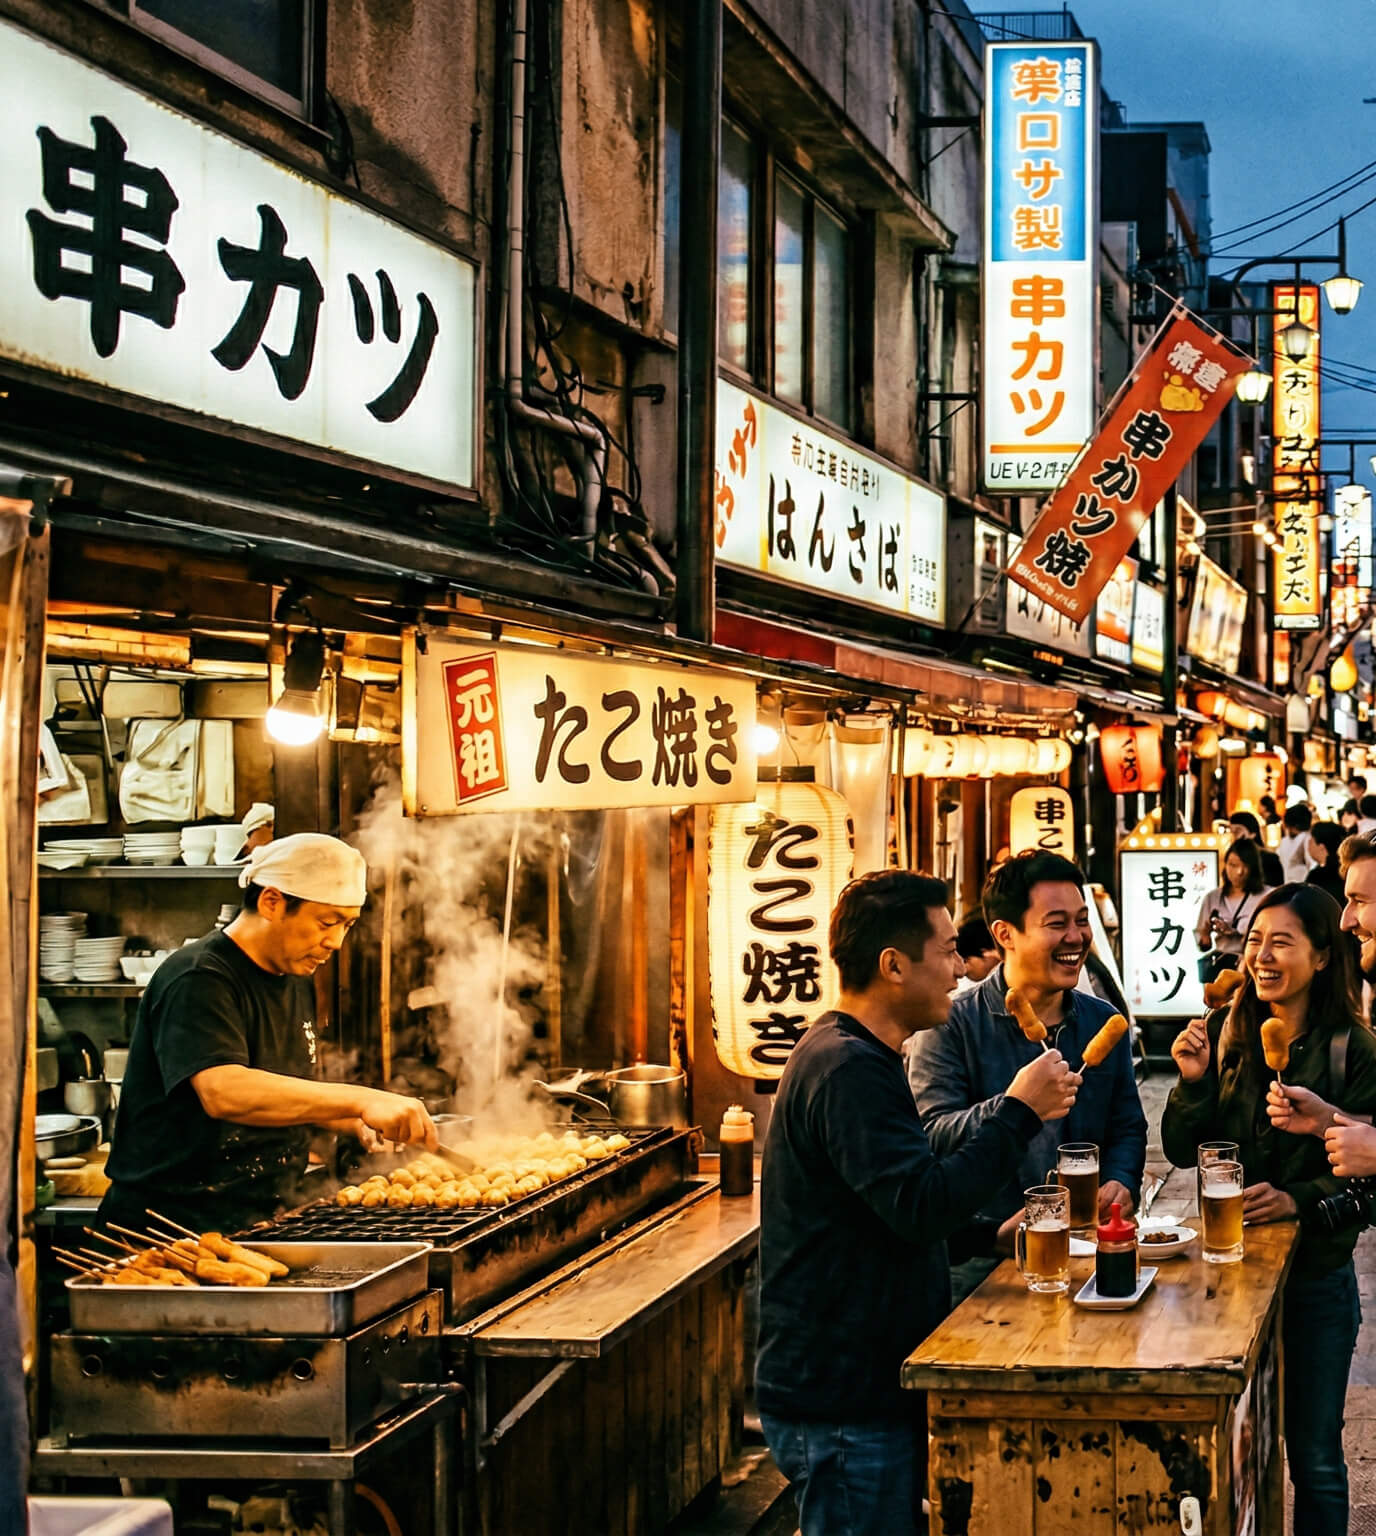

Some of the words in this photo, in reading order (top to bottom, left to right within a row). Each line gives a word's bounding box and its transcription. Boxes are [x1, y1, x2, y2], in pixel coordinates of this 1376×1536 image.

[26, 115, 439, 423] 串カツ
[1010, 275, 1066, 437] 串カツ
[767, 472, 900, 594] はんさば
[455, 668, 500, 788] 元祖
[534, 674, 738, 788] たこ焼き
[743, 811, 822, 1066] たこ焼き
[1147, 866, 1187, 1004] 串カツ
